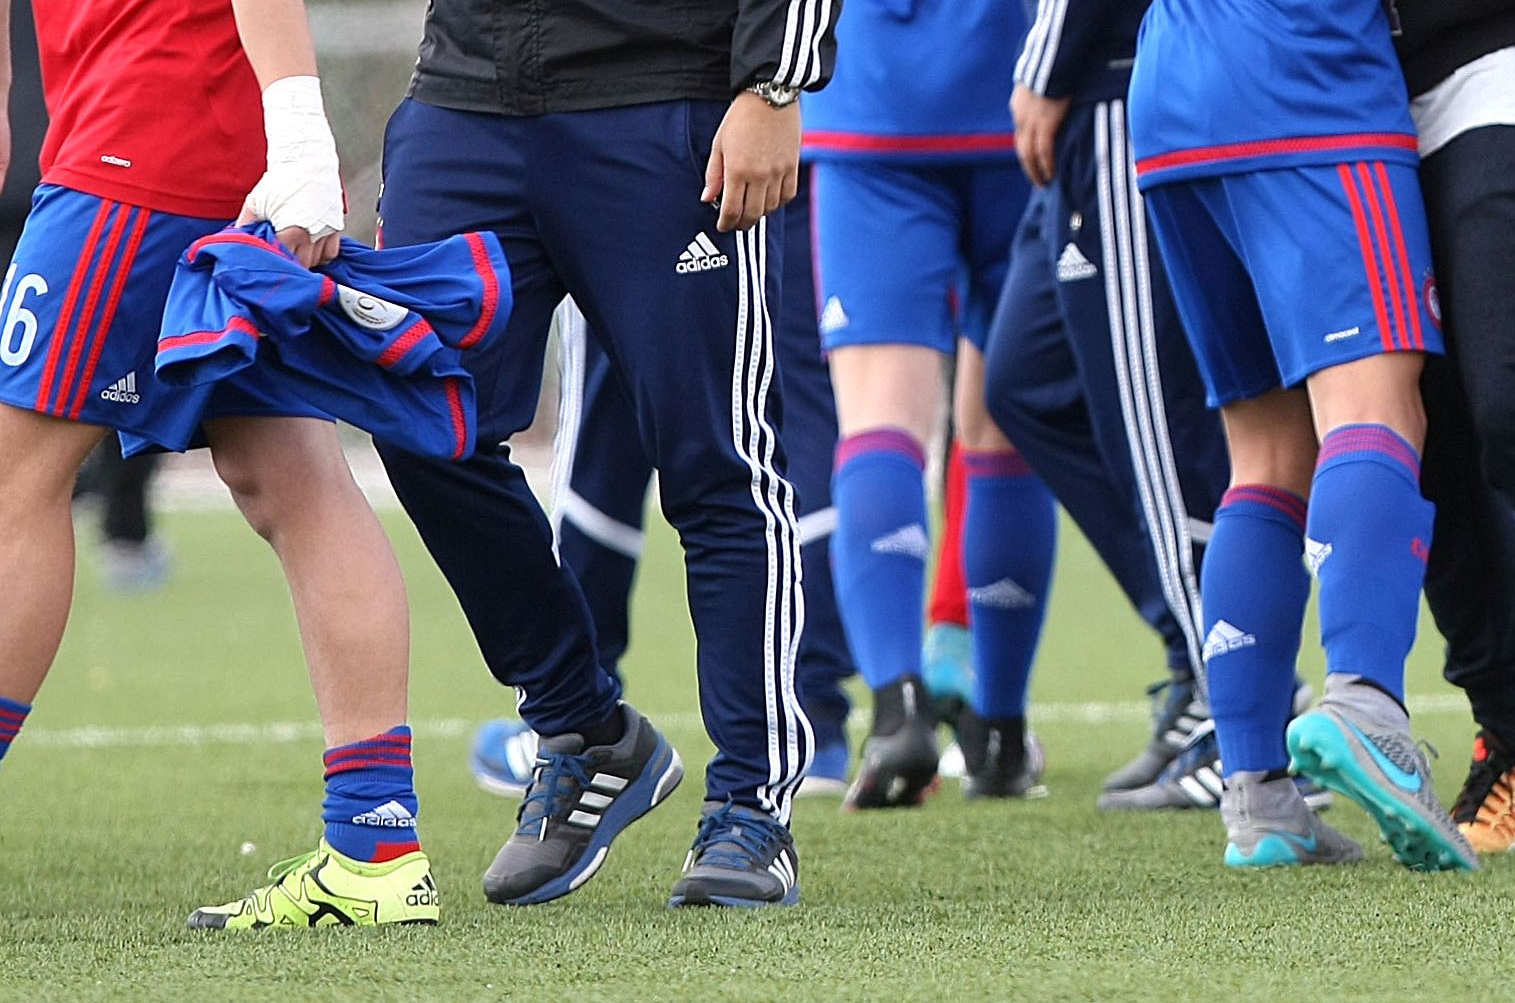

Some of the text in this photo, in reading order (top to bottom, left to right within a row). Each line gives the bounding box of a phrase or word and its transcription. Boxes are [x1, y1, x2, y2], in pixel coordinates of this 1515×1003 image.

[675, 254, 729, 274] adidas
[101, 388, 141, 405] adidas
[352, 815, 418, 828] adidas
